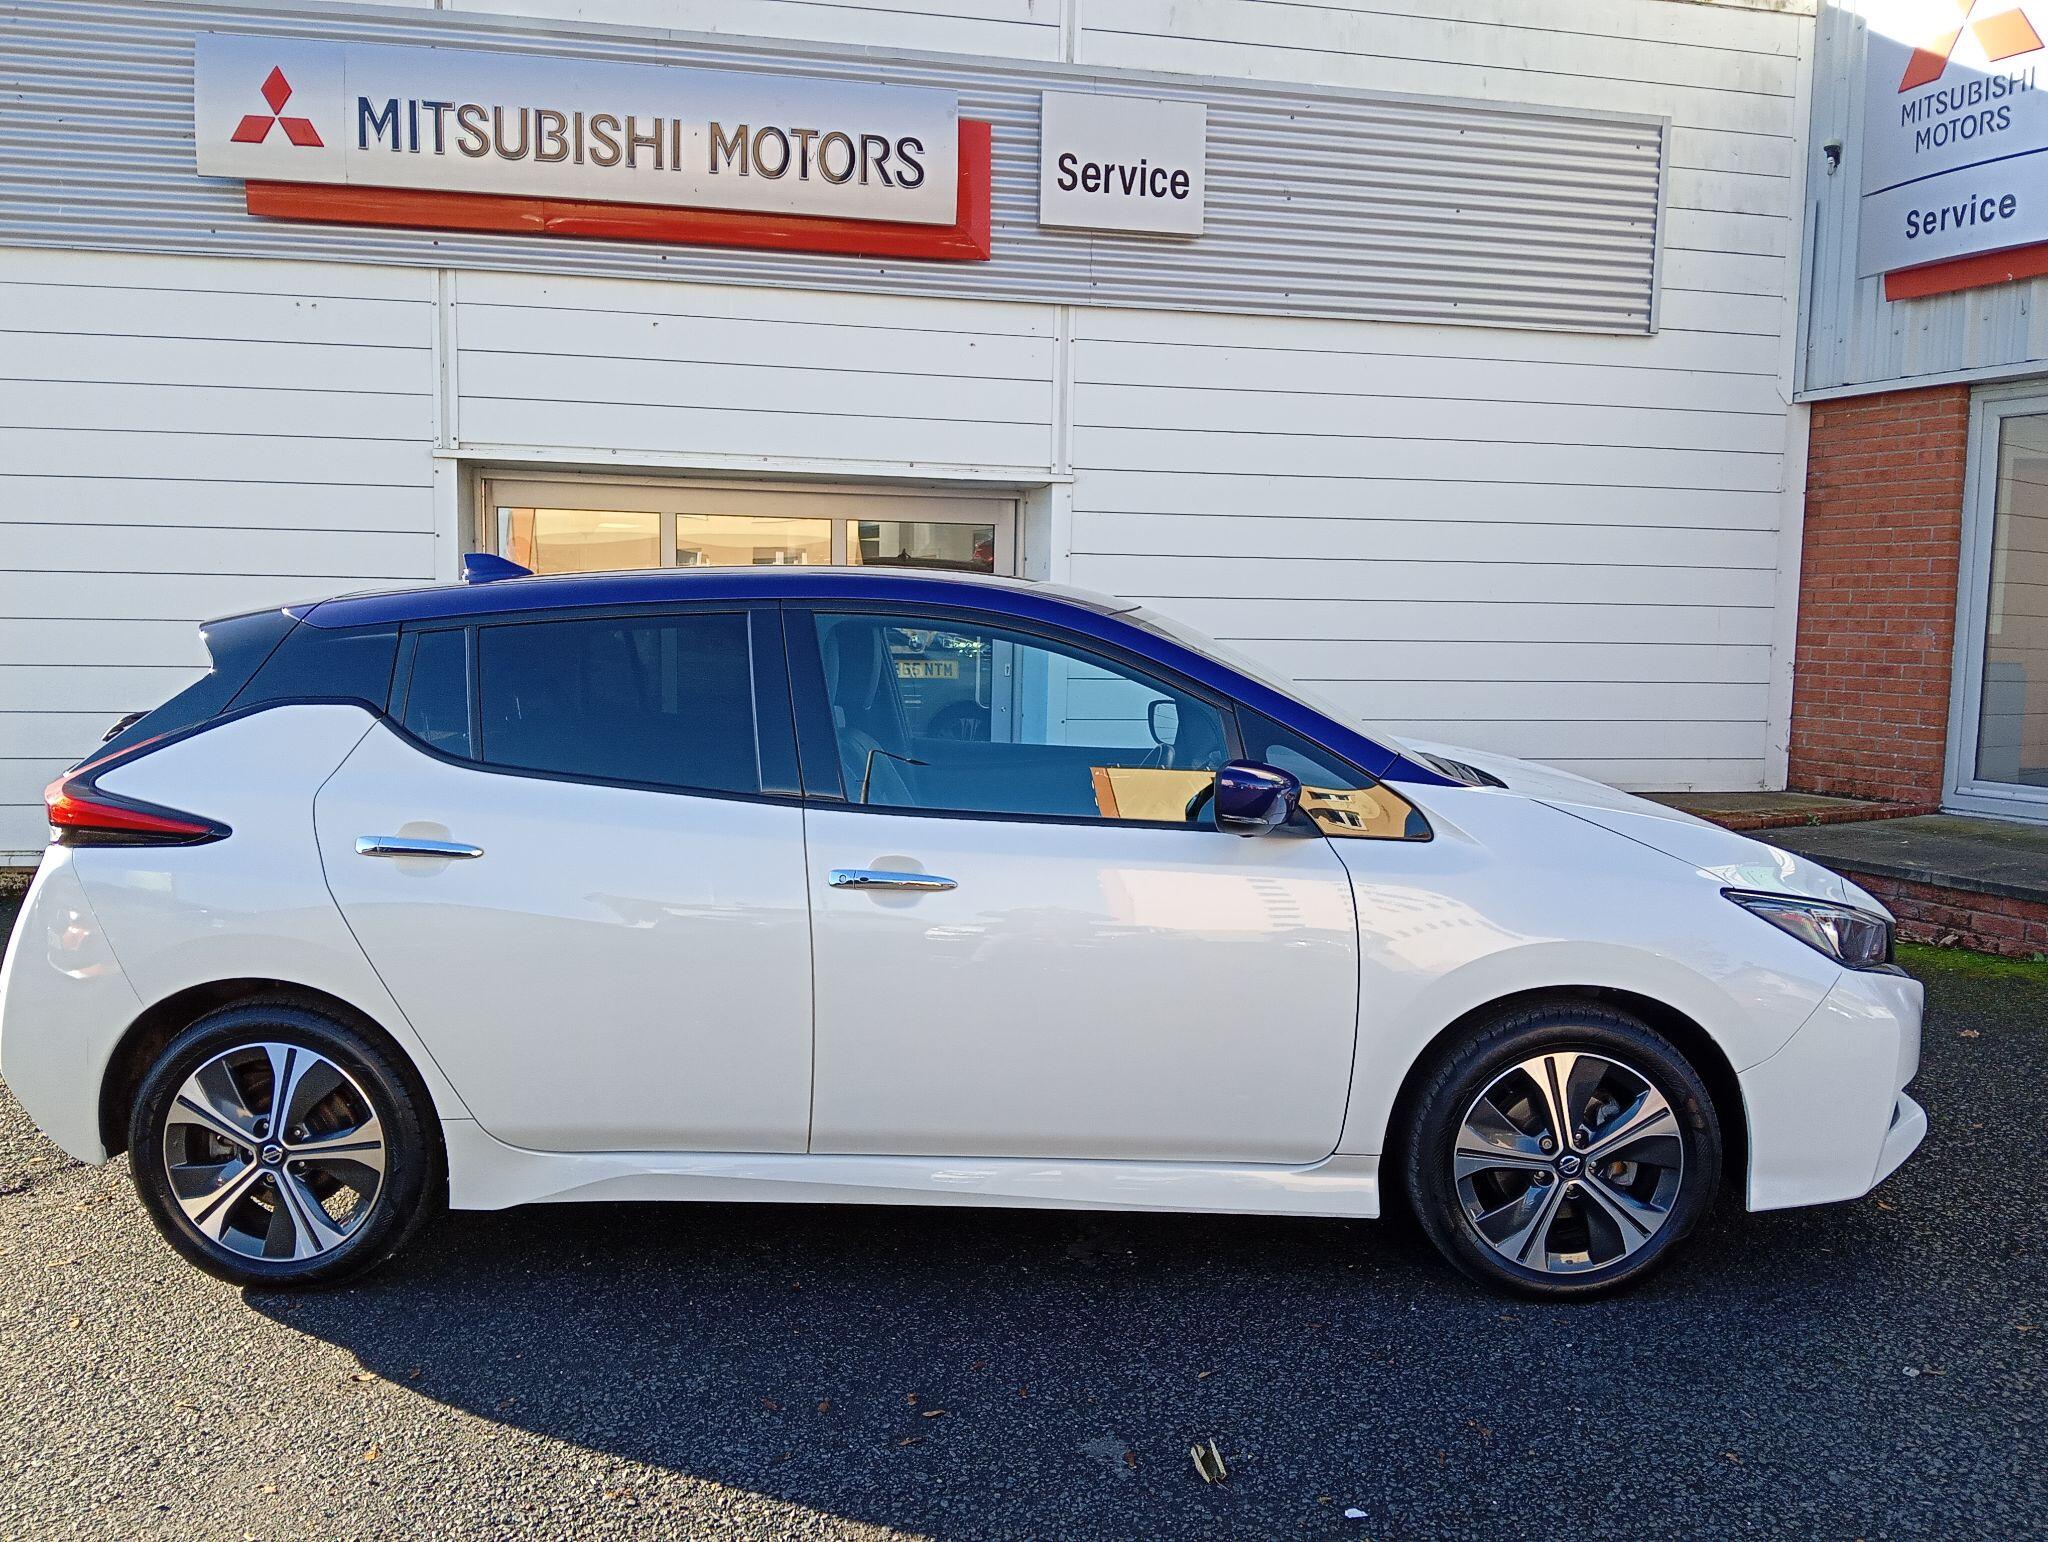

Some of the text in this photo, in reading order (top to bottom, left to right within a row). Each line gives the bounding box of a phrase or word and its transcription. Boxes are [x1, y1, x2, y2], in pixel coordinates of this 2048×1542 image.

[1901, 66, 2036, 127] MITSUBISHI
[357, 96, 925, 189] MITSUBISHI MOTORS
[1915, 105, 2011, 153] MOTORS
[1057, 152, 1190, 200] Service
[1905, 193, 2017, 239] Service
[924, 662, 953, 677] NTM
